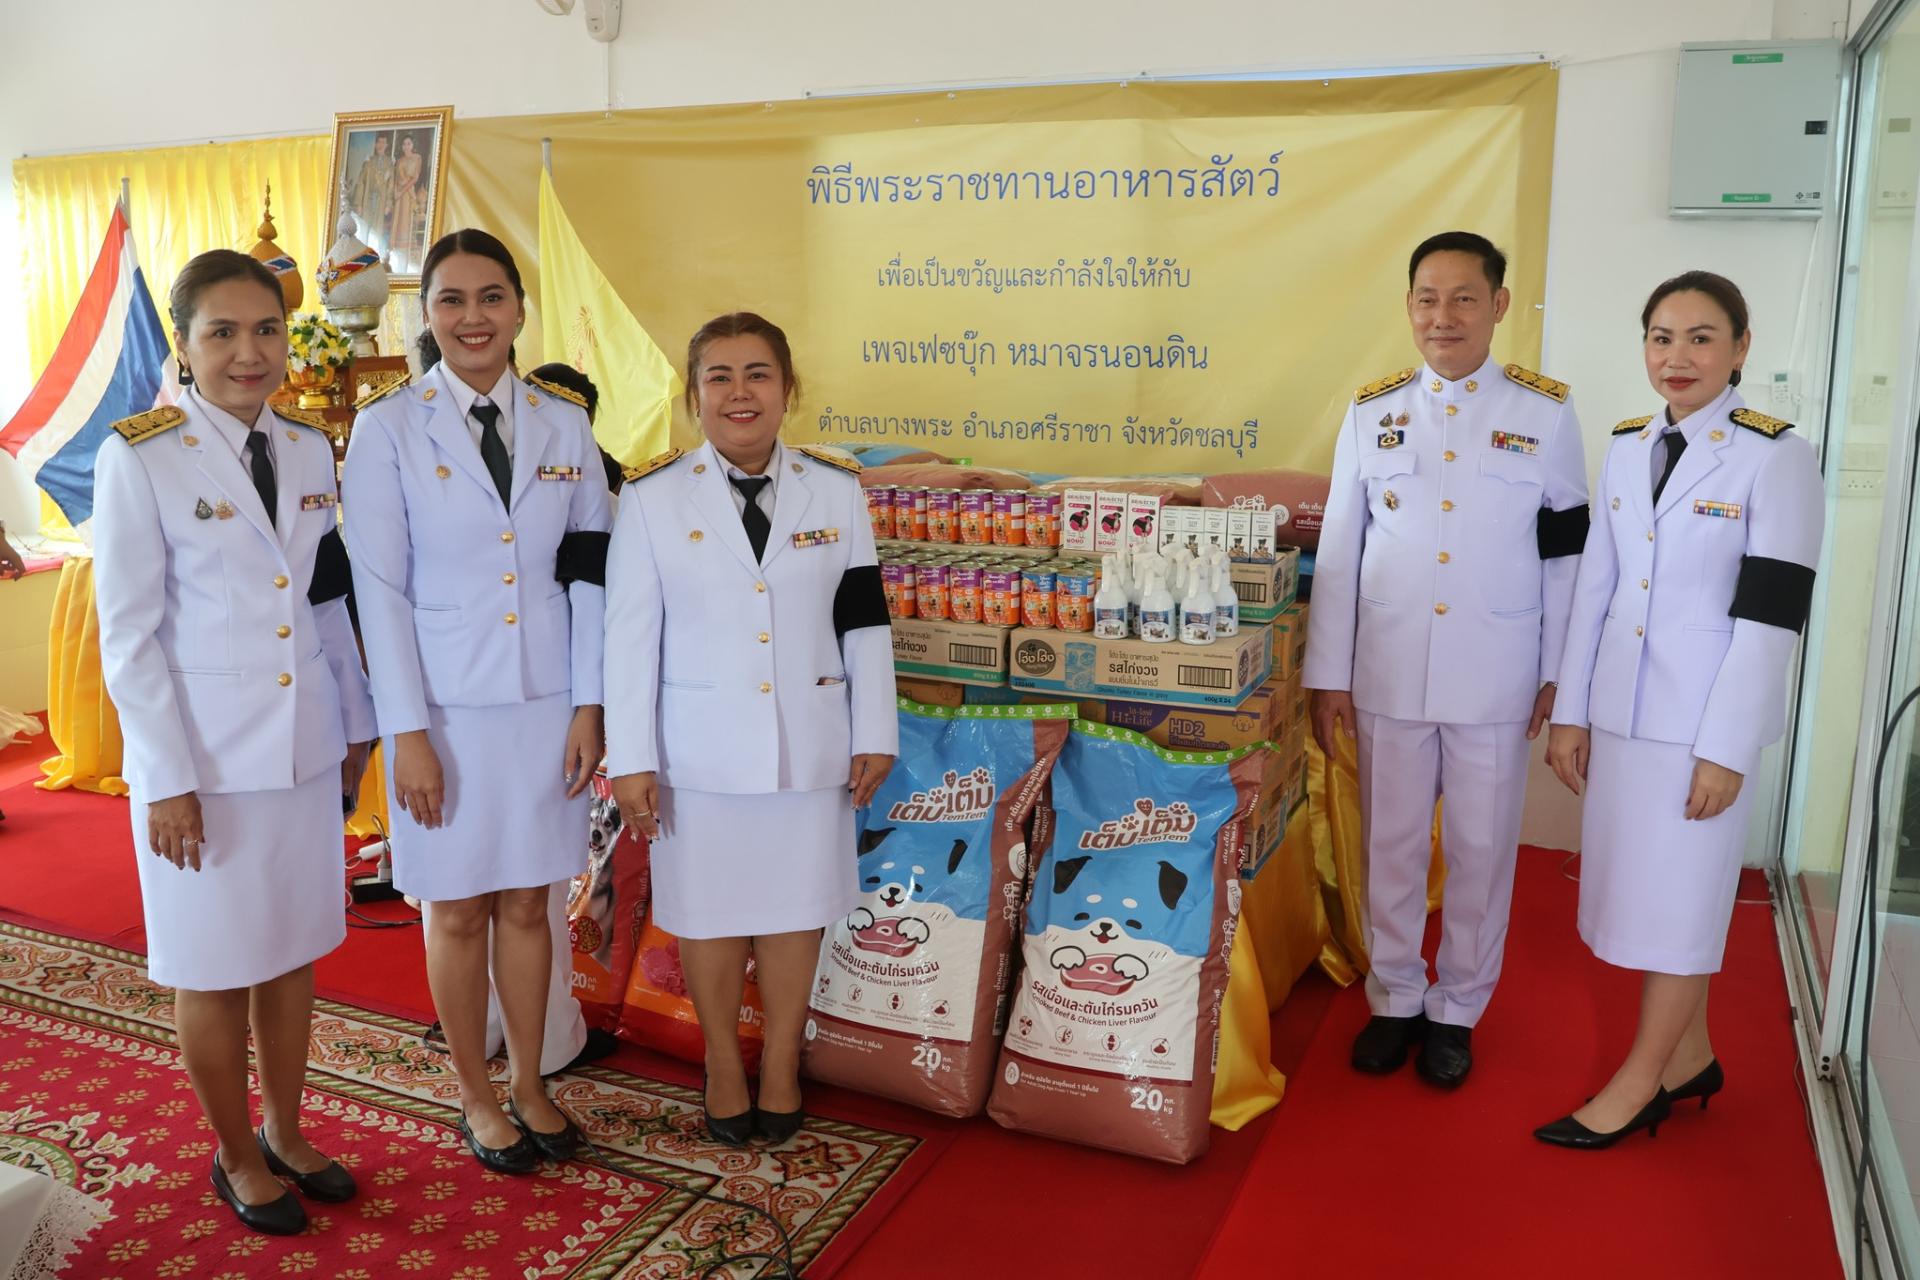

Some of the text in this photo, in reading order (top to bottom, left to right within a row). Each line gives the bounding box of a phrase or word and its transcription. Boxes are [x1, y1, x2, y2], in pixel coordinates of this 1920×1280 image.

[806, 150, 1285, 204] พิธีพระราชทานอาหารสัตว์
[877, 252, 1191, 294] เพื่อเป็นขวัญและกำลังใจให้กับ
[862, 329, 1209, 376] เพจเฟซบุ๊ก หมาจรนอนดิน
[818, 406, 1259, 458] ตำบลบางพระ อำเภอศรีราชา จังหวัดชลบุรี
[1109, 660, 1158, 677] รสไก่งวง
[1169, 717, 1206, 738] HD2
[941, 810, 988, 822] TemTem
[1137, 834, 1189, 844] TemTem
[831, 940, 940, 977] รสเนื้อและตับไก่รมควัน
[866, 975, 892, 987] Chicken
[1031, 980, 1159, 1017] รสเนื้อและตับไก่รมควัน
[1054, 1006, 1070, 1021] Beef
[1078, 1014, 1107, 1027] Chicken
[1108, 1018, 1127, 1027] Liver
[1128, 1011, 1157, 1025] Flavour
[911, 1045, 942, 1071] 20
[942, 1064, 950, 1072] kg
[1130, 1087, 1163, 1112] 20
[1163, 1105, 1173, 1114] kg
